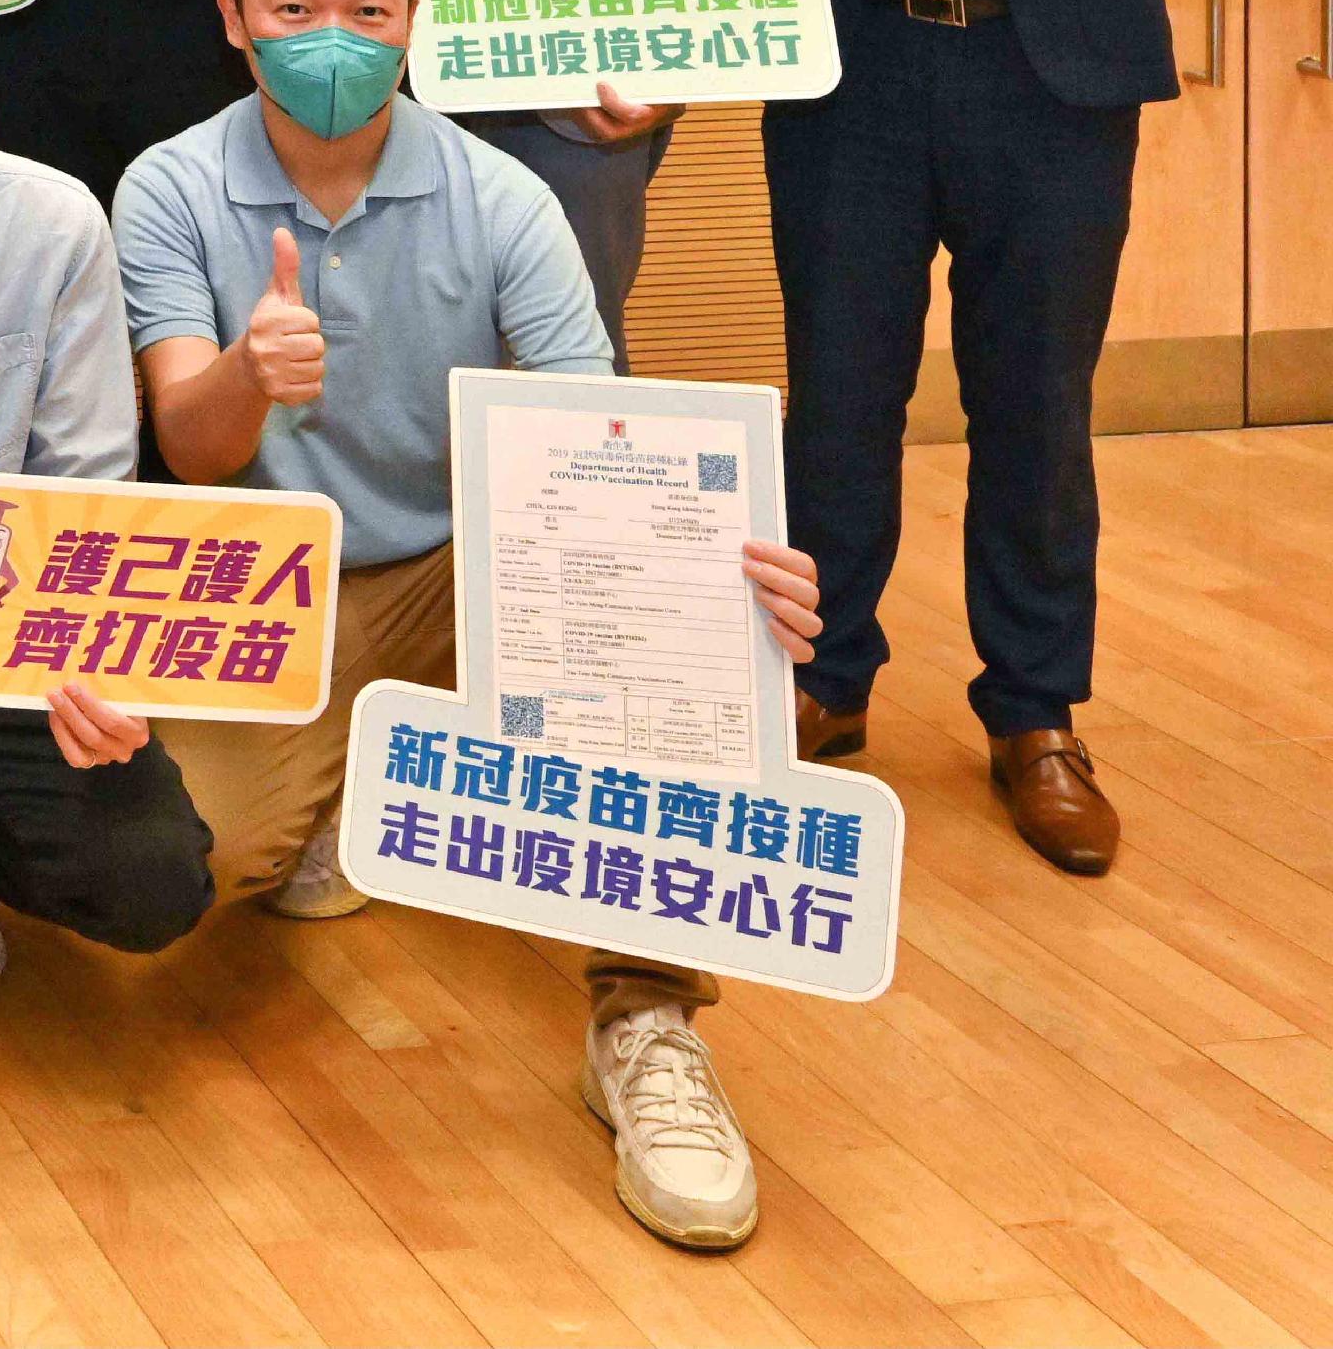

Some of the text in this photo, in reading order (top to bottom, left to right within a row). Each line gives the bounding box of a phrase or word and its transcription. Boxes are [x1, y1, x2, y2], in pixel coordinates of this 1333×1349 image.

[437, 19, 802, 81] 走出疫境安心行
[548, 448, 569, 459] 2019
[570, 461, 667, 477] Department of Health
[602, 439, 633, 452] 衛生署
[550, 471, 689, 489] COVID-19 Vaccination Record
[35, 529, 315, 608] 護己護人
[2, 606, 297, 685] 齊打疫苗
[383, 722, 864, 880] 新冠疫苗齊接種
[376, 800, 854, 955] 走出疫境安心行
